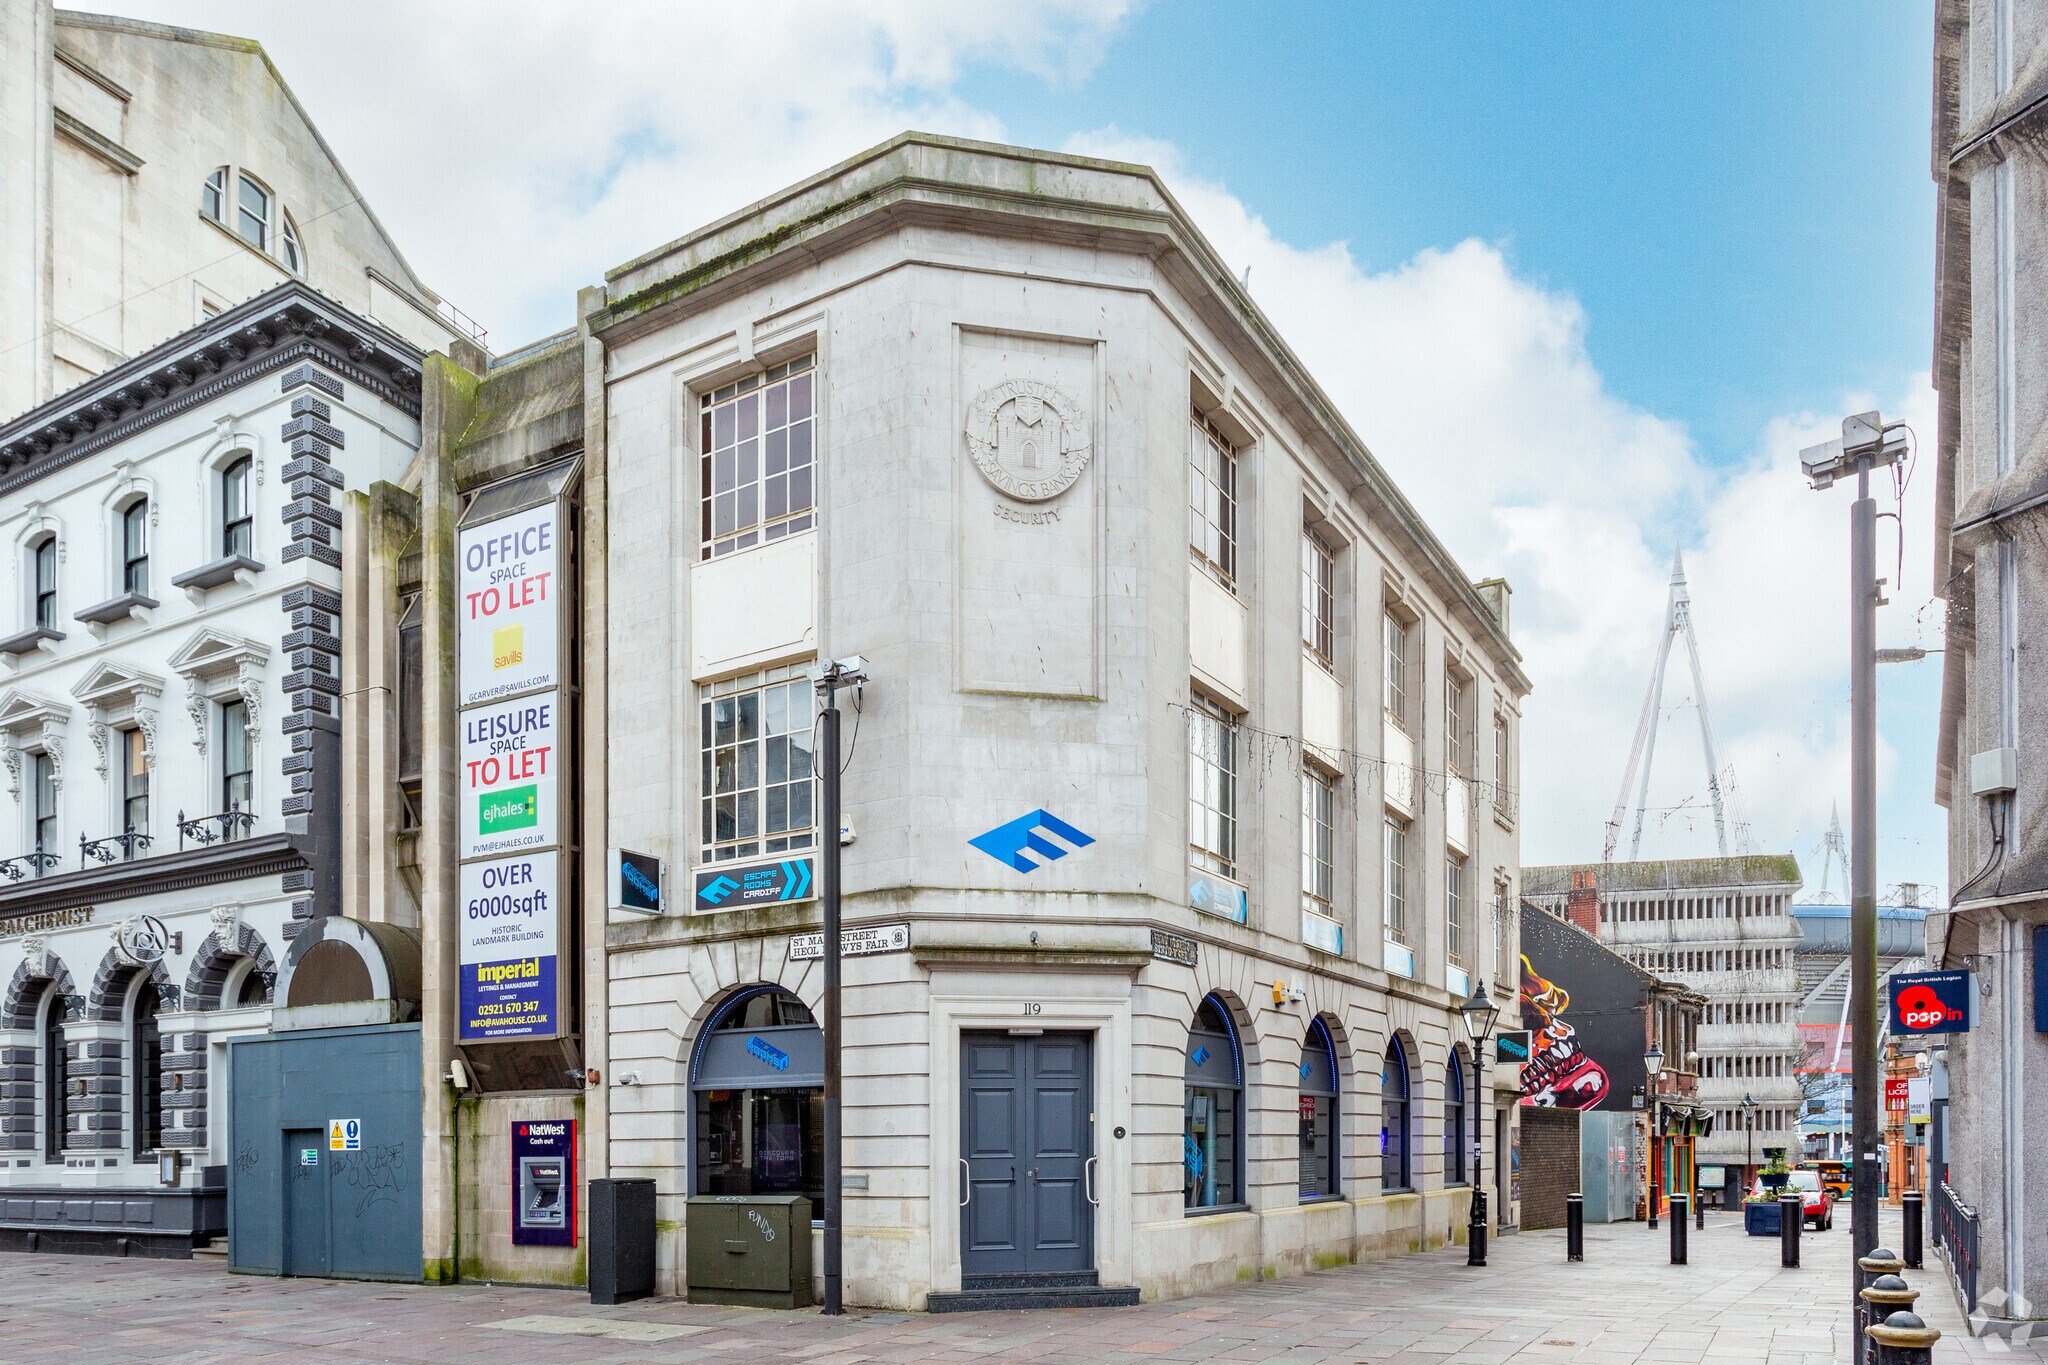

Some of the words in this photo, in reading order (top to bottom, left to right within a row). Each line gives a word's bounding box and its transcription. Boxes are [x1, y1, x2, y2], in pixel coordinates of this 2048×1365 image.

[995, 380, 1062, 406] TRUSTEE
[984, 462, 1037, 497] SAVINGS
[1041, 470, 1076, 497] BANK
[992, 504, 1061, 525] SECURITY
[466, 521, 551, 572] OFFICE
[490, 562, 527, 585] SPACE
[466, 587, 500, 620] TO
[508, 572, 551, 610] LET
[494, 650, 522, 668] savills
[468, 674, 550, 702] GCARVER@SAVILLS.COM
[468, 704, 550, 744] LEISURE
[490, 735, 526, 756] SPACE
[467, 757, 500, 788] TO
[508, 746, 551, 781] LET
[483, 801, 523, 823] ejhales
[472, 834, 545, 853] PVM@EJHALES.CO.UK
[482, 862, 533, 889] OVER
[743, 869, 778, 881] ESCAPE
[743, 880, 772, 890] ROOMS
[743, 887, 781, 899] CARDIFF
[468, 889, 548, 920] 6000sqft
[6, 906, 95, 935] ALCHEMIST
[491, 924, 522, 935] HISTORIC
[472, 934, 510, 947] LANDMARK
[511, 930, 544, 943] BUILDING
[793, 938, 805, 947] ST
[840, 930, 878, 942] STREET
[793, 947, 819, 957] HEOL
[865, 939, 889, 950] FAIR
[477, 957, 539, 984] imperial
[478, 1004, 503, 1016] 02921
[505, 1002, 521, 1013] 670
[523, 1001, 539, 1012] 347
[1024, 1003, 1041, 1015] 119
[1907, 1011, 1942, 1026] pop
[1947, 1007, 1963, 1021] in
[470, 1014, 548, 1028] INFO@AVAHOUSE.CO.UK
[529, 1124, 565, 1136] NatWest
